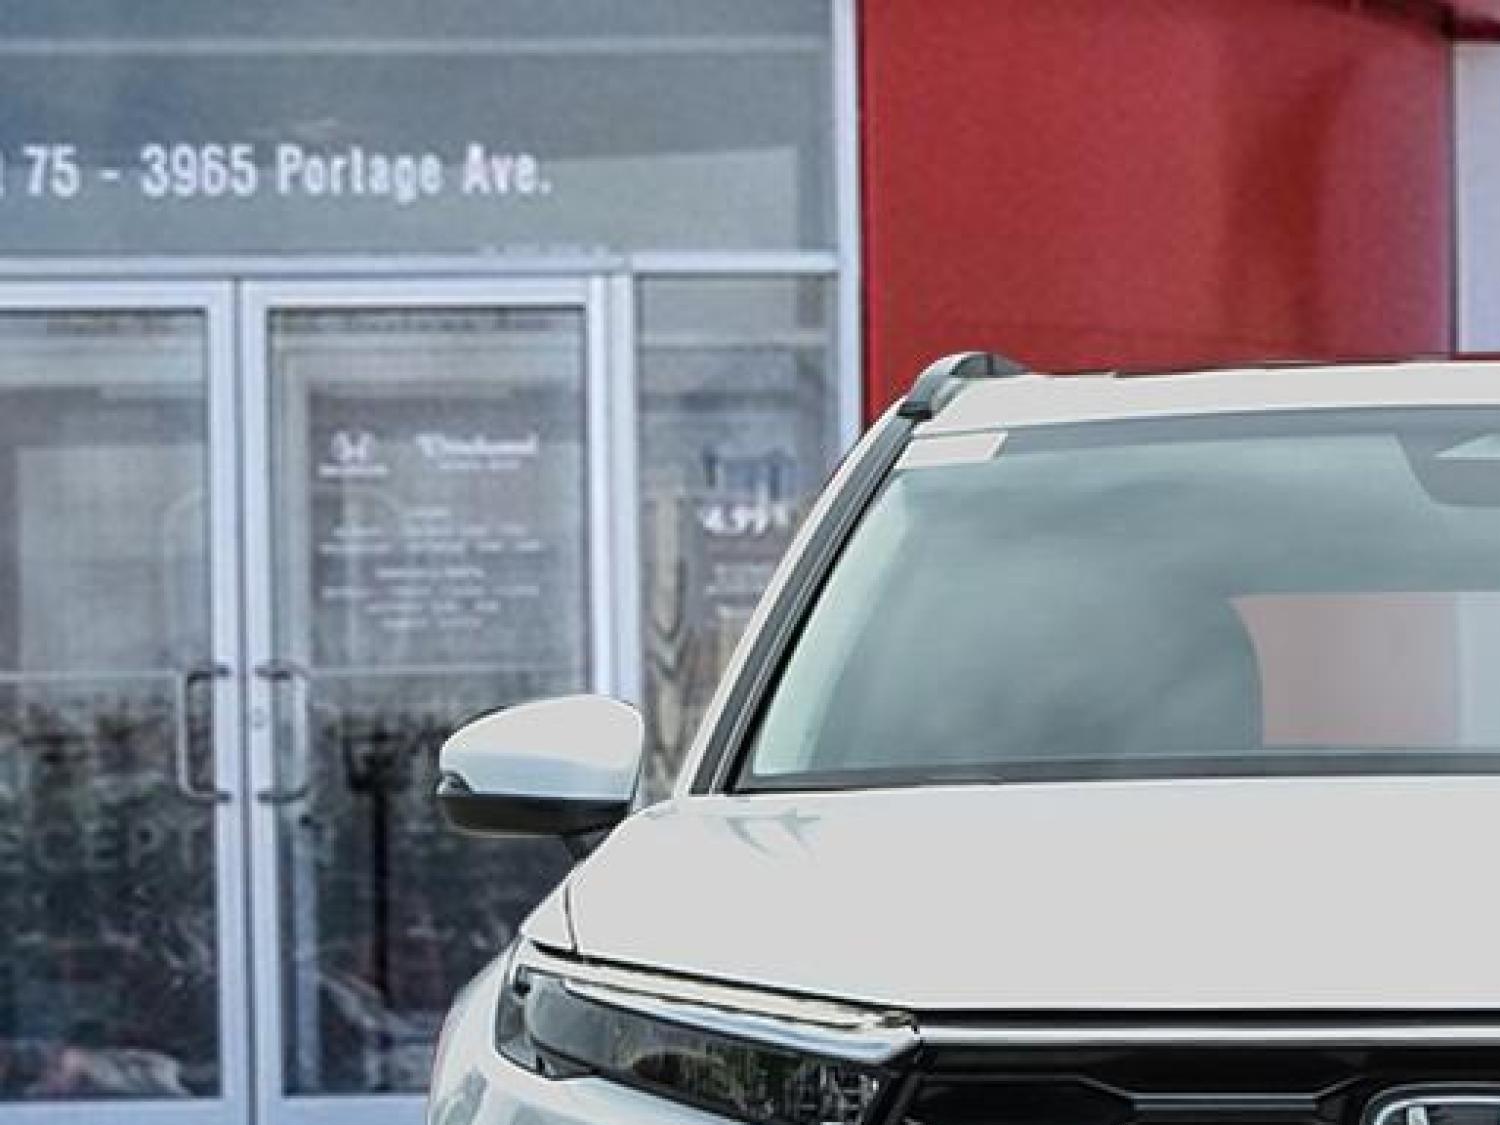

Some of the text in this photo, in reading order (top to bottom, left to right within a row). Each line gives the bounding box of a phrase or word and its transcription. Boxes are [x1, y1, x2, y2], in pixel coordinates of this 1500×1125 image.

[22, 143, 79, 197] 75
[101, 169, 121, 181] -
[140, 143, 257, 197] 3965
[275, 142, 441, 204] Portage
[462, 142, 552, 194] Ave.
